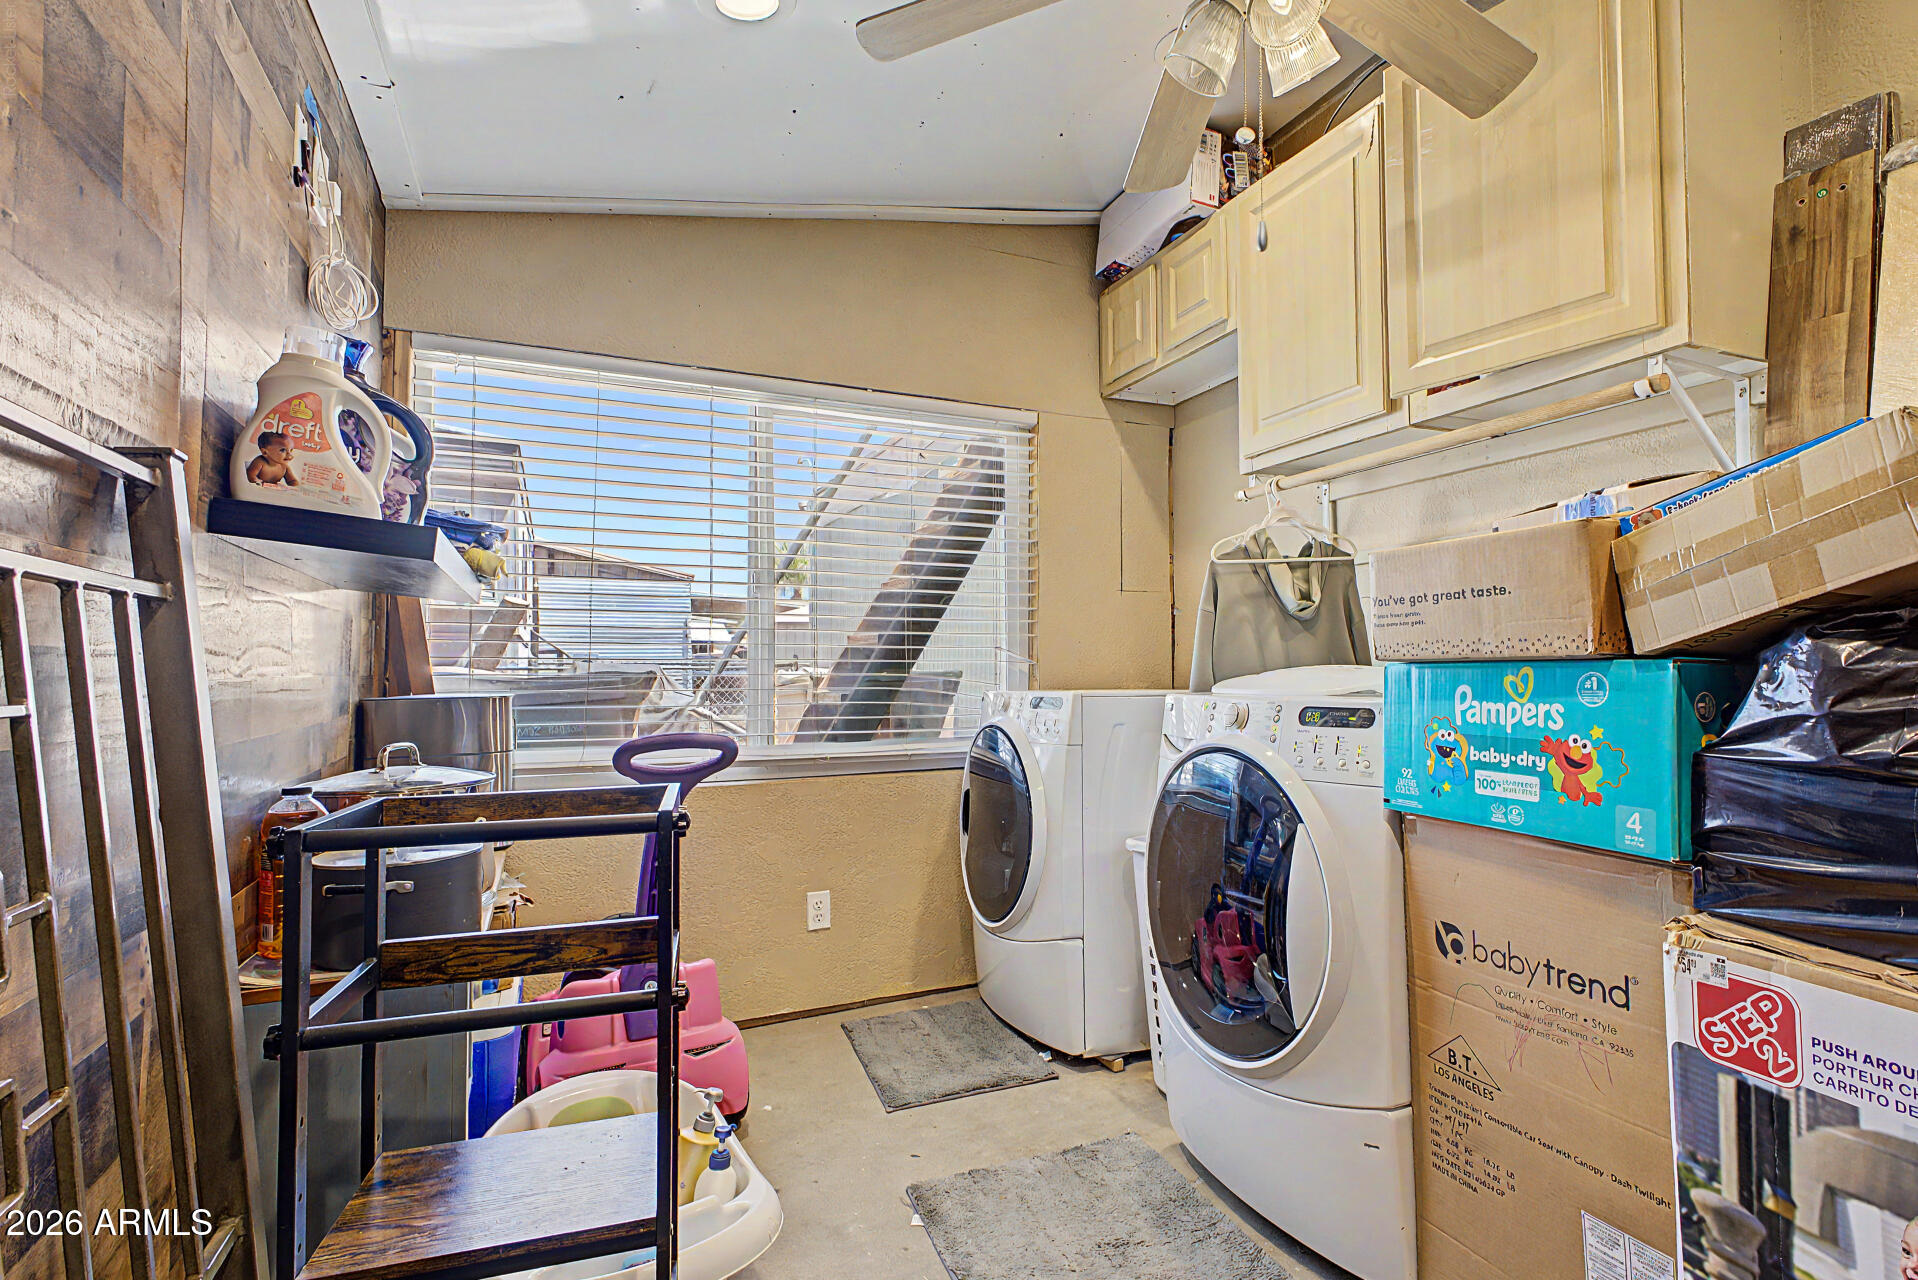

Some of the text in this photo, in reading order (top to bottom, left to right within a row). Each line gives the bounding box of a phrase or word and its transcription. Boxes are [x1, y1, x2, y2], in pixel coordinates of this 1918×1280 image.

[261, 413, 322, 442] dreft
[1372, 584, 1512, 608] You've got great taste.
[1454, 684, 1565, 734] Pampers
[1401, 767, 1413, 779] 92
[1626, 812, 1642, 834] 4
[1494, 984, 1527, 1005] Quality
[1537, 1000, 1579, 1021] Comfort
[1591, 1018, 1618, 1035] Style
[1700, 990, 1782, 1057] STEP
[1753, 1035, 1796, 1078] 2
[1811, 1036, 1918, 1082] PUSH AROU
[1812, 1053, 1894, 1092] PORTEUR
[1433, 1063, 1495, 1102] LOS ANGELES
[1812, 1071, 1890, 1107] CARRITO
[1573, 1155, 1604, 1178] Canopy
[1611, 1173, 1632, 1191] Dash
[1634, 1183, 1672, 1211] Twilight
